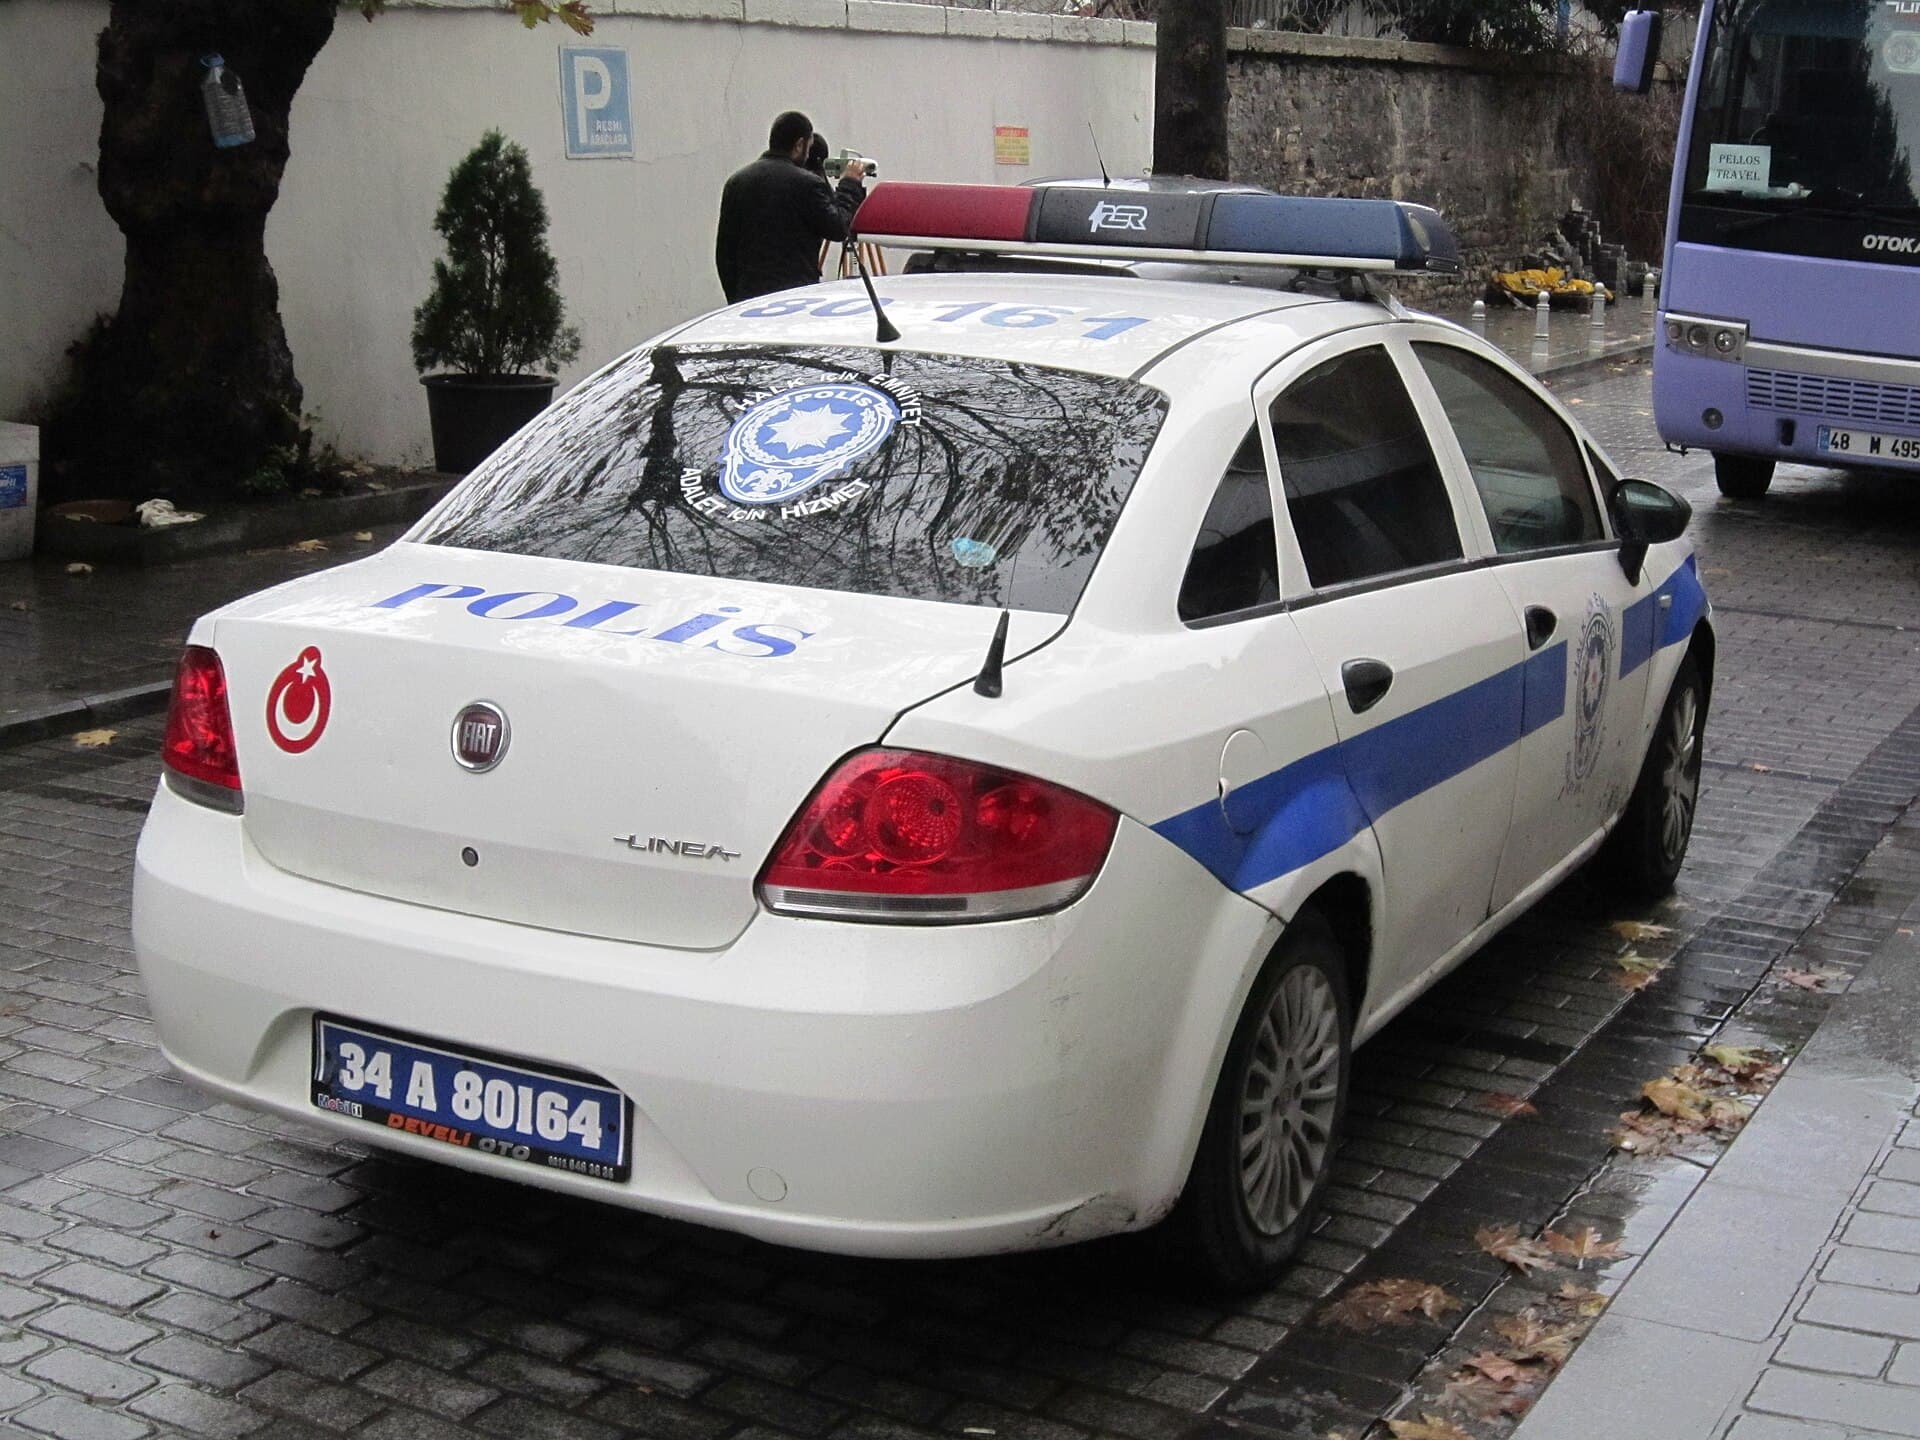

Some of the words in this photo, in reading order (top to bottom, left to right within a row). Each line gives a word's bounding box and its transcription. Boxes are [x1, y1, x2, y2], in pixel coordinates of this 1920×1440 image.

[574, 56, 611, 144] P
[1716, 168, 1760, 181] TRAVEL
[1719, 154, 1760, 165] PELLOS
[734, 377, 805, 410] HALK
[1831, 432, 1850, 450] 48
[1870, 436, 1881, 454] M
[1891, 439, 1920, 459] 495
[680, 468, 727, 516] ADALET
[462, 721, 497, 753] FIAT
[614, 834, 741, 862] LINEA
[339, 1042, 392, 1100] 34
[405, 1060, 437, 1113] A
[452, 1070, 602, 1150] 80164
[478, 1137, 530, 1162] OTO
